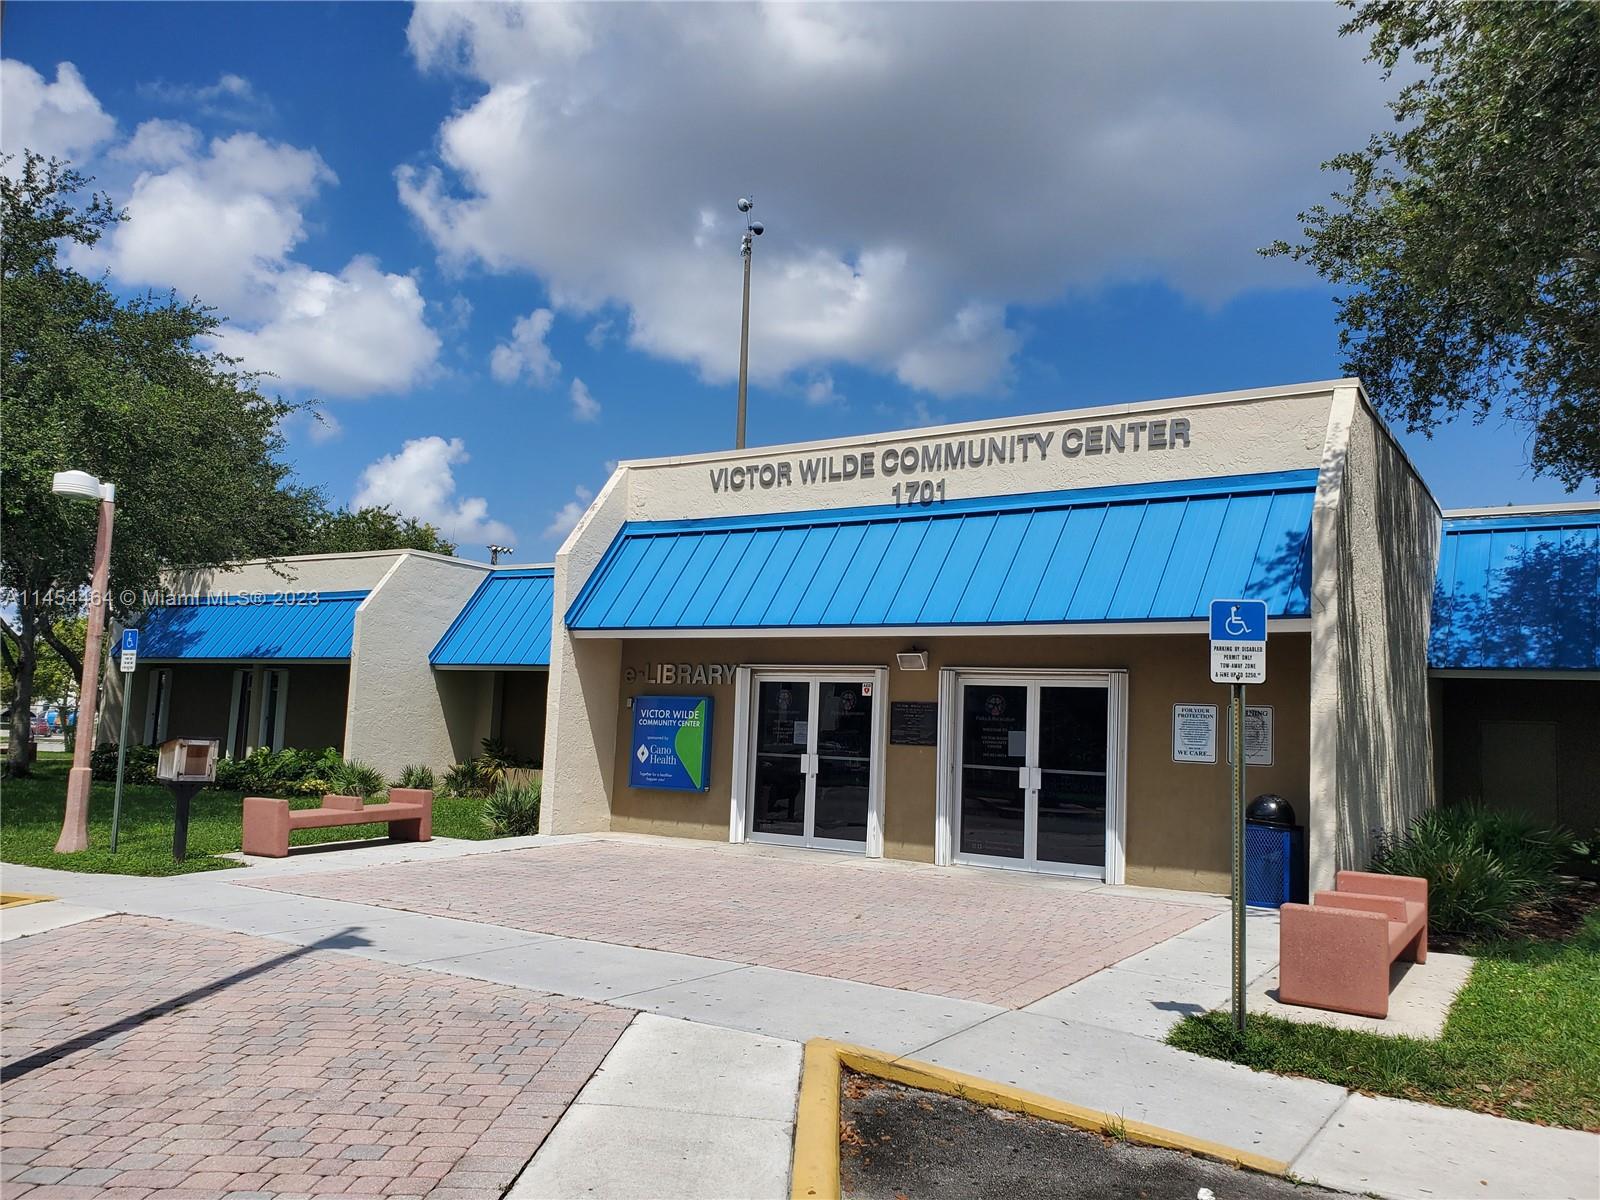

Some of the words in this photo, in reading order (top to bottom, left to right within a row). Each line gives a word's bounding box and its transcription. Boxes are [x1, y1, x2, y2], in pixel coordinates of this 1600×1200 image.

[709, 462, 793, 493] VICTOR
[799, 451, 876, 485] WILDE
[881, 431, 1055, 476] COMMUNITY
[1061, 417, 1191, 458] CENTER
[891, 478, 946, 508] 1701
[623, 663, 737, 686] e-LIBRARY
[640, 709, 671, 719] VICTOR
[672, 710, 700, 720] WILDE
[638, 718, 676, 727] COMMUNITY
[677, 720, 701, 728] CENTER
[650, 744, 672, 755] Cano
[650, 754, 677, 765] Health
